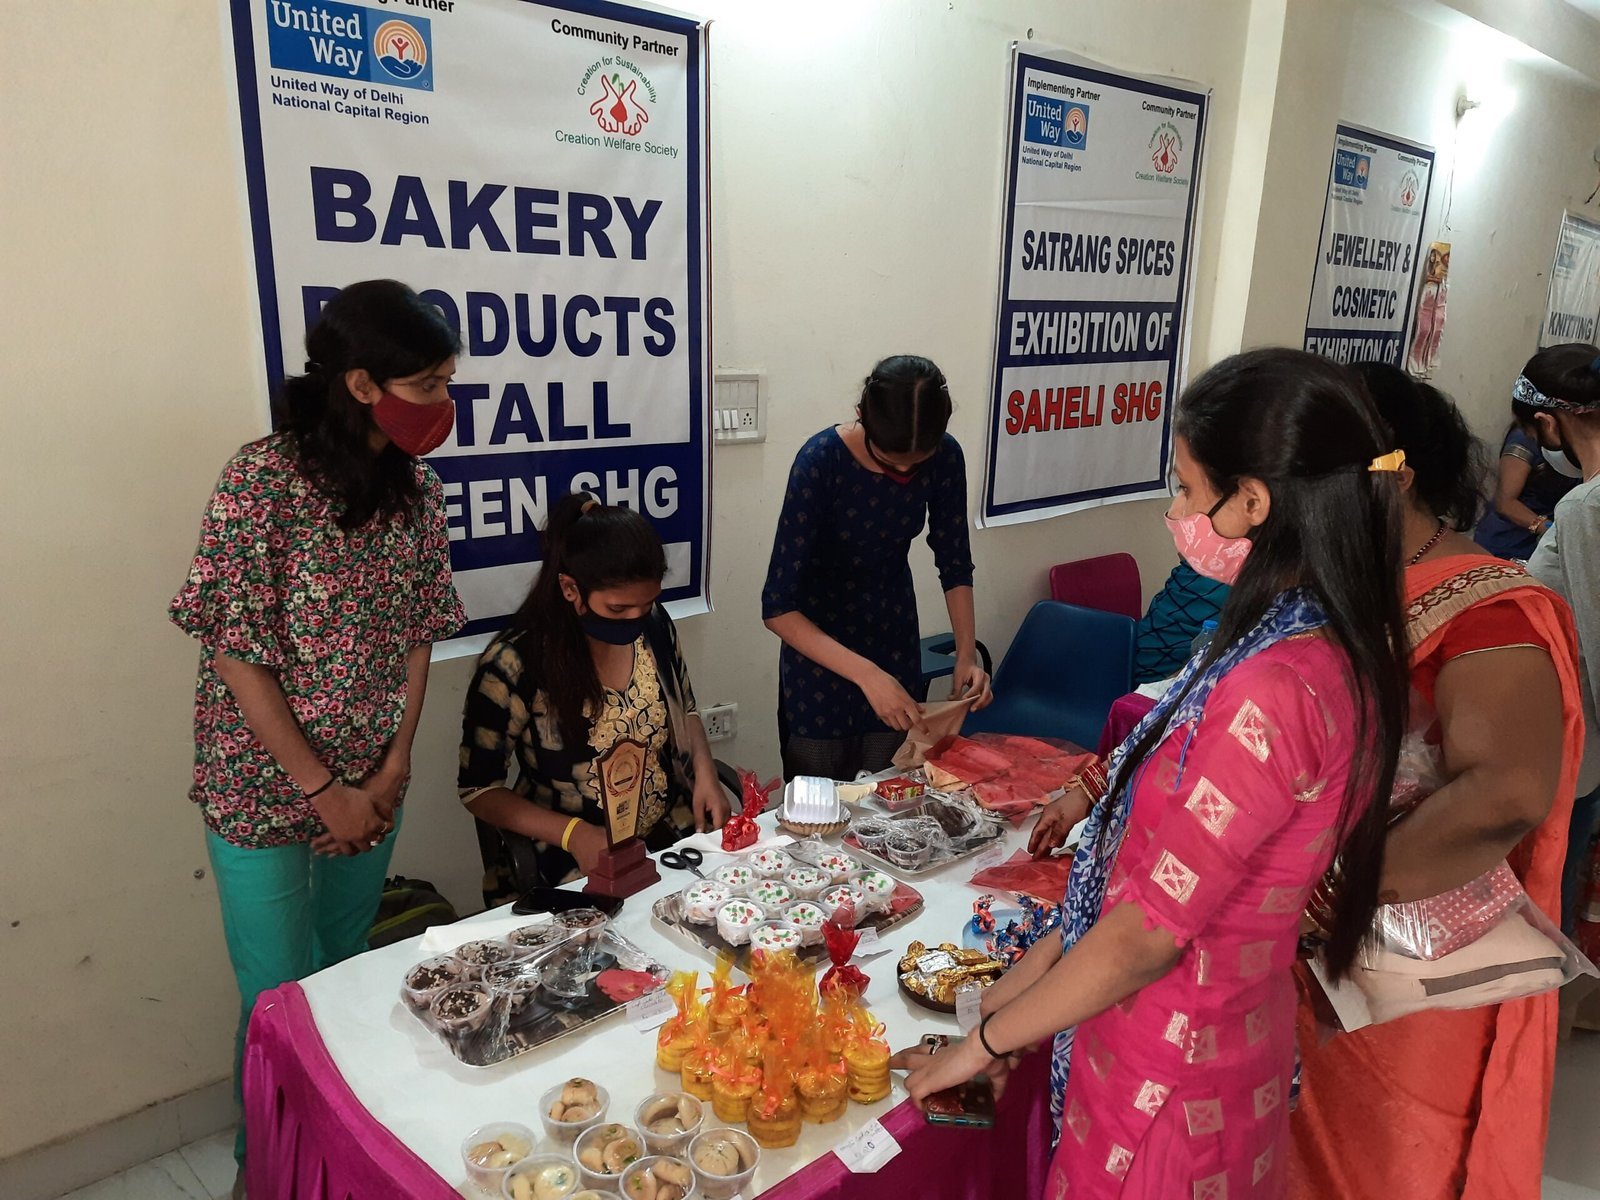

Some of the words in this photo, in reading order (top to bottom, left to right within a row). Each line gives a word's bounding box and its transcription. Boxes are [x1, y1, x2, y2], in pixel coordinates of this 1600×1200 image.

[271, 0, 362, 40] United
[394, 0, 454, 12] artner
[551, 19, 629, 50] Community
[633, 35, 679, 56] Partner
[309, 36, 363, 76] Way
[271, 75, 320, 92] United
[320, 82, 349, 100] Way
[354, 88, 367, 99] of
[371, 90, 404, 105] Delhi
[577, 61, 602, 96] Creation
[602, 56, 613, 66] for
[615, 56, 656, 104] Sustainability
[1028, 77, 1074, 98] Implementing
[1077, 87, 1100, 101] Partner
[272, 92, 330, 111] National
[334, 101, 380, 118] Capital
[385, 108, 429, 125] Region
[1028, 100, 1061, 121] United
[1142, 101, 1175, 118] Community
[1176, 107, 1196, 120] Partner
[555, 130, 600, 146] Creation
[603, 136, 641, 151] Welfare
[645, 141, 678, 159] Society
[1041, 120, 1061, 143] Way
[1022, 156, 1043, 167] National
[1044, 160, 1063, 170] Capital
[1064, 162, 1081, 172] Region
[1023, 146, 1040, 156] United
[1041, 148, 1052, 158] Way
[1060, 151, 1073, 160] Delhi
[1337, 153, 1356, 168] United
[310, 166, 664, 261] BAKERY
[1022, 229, 1111, 274] SATRANG
[1115, 236, 1175, 276] SPICES
[1326, 232, 1401, 272] JEWELLERY
[1402, 244, 1411, 273] &
[1332, 285, 1397, 319] COSMETIC
[1009, 311, 1140, 356] EXHIBITION
[1145, 311, 1172, 351] OF
[445, 381, 631, 447] TALL
[1005, 384, 1105, 436] SAHELI
[1111, 380, 1162, 425] SHG
[444, 475, 547, 542] EEN
[570, 465, 679, 519] SHG
